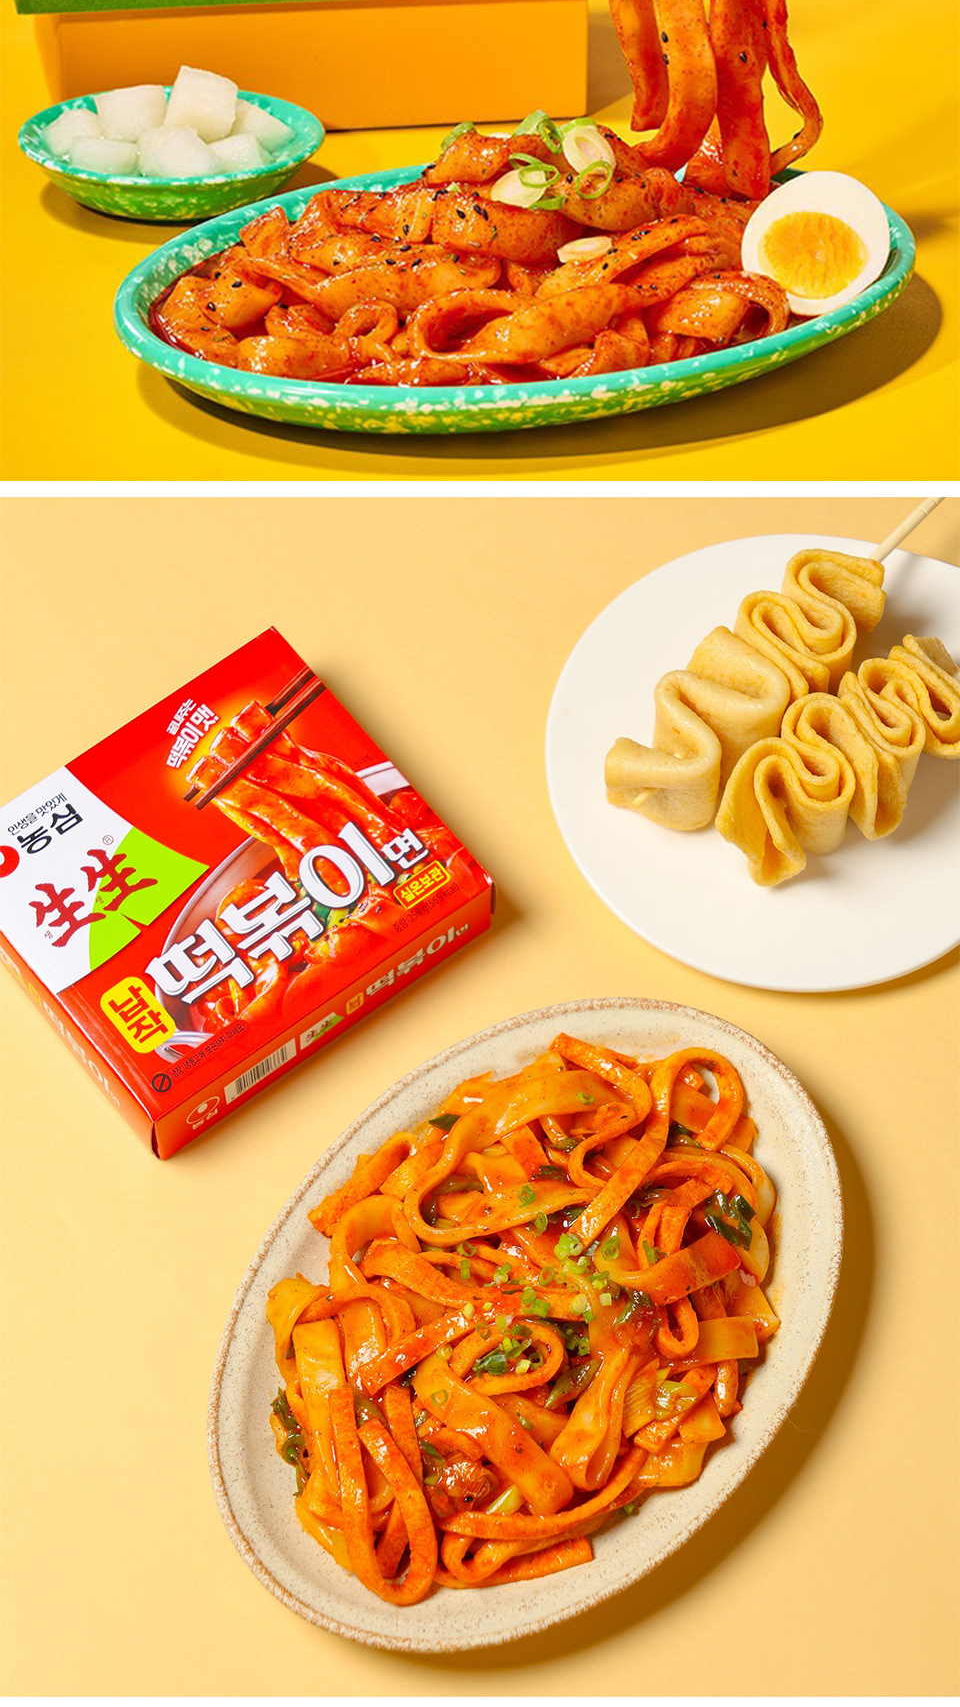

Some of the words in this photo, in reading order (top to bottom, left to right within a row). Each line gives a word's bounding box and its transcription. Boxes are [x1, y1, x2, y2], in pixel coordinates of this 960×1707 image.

[166, 698, 197, 735] 끝내주는
[166, 721, 205, 768] 떡볶이
[7, 814, 39, 836] 인생을
[36, 792, 68, 816] 맛있게
[16, 803, 84, 854] 농심
[29, 849, 159, 948] 生生
[400, 867, 445, 903] 실온보관
[108, 984, 169, 1045] 납작
[205, 1035, 228, 1055] 보관하지
[226, 1021, 245, 1039] 마세요!
